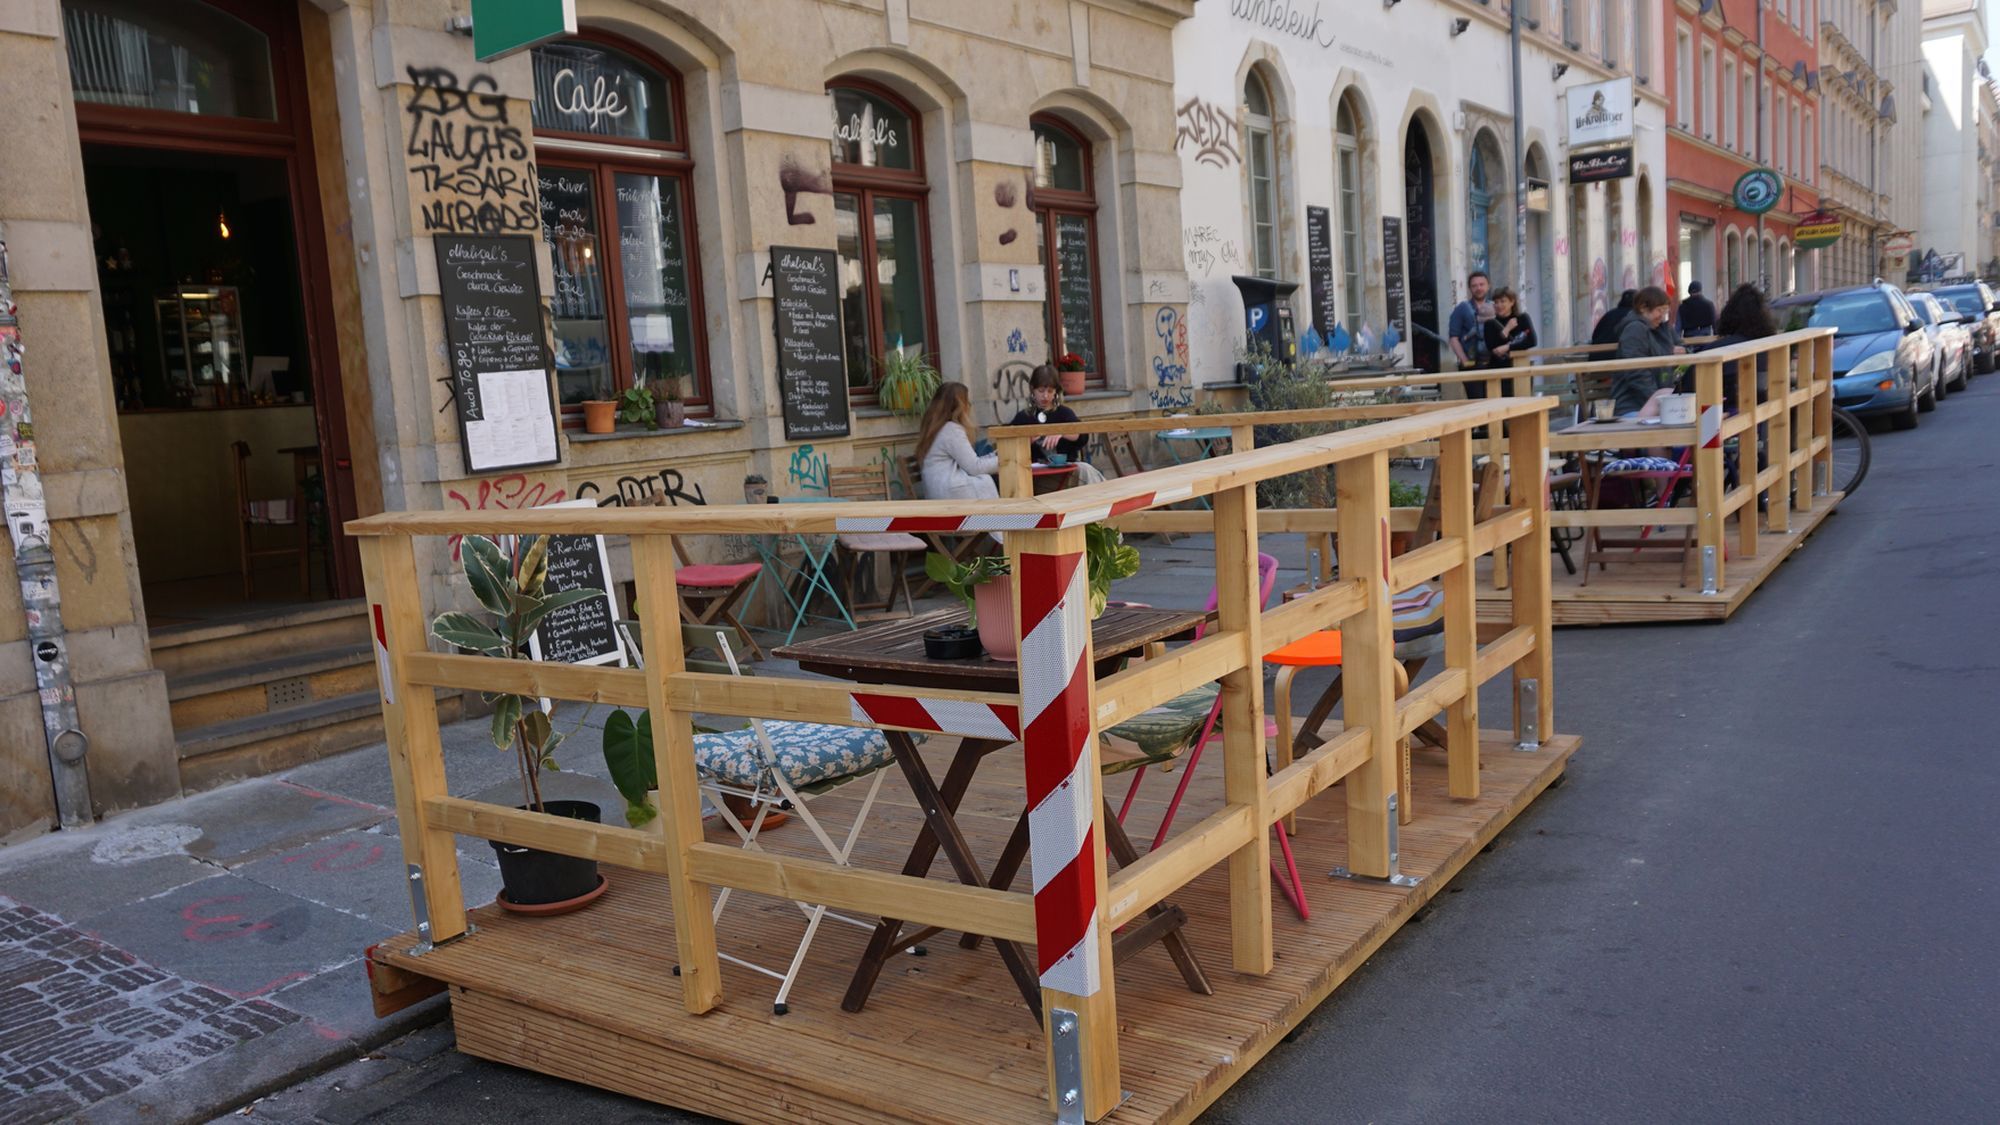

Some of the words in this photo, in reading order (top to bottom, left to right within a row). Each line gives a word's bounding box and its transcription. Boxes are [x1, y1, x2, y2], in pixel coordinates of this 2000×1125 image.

[553, 68, 628, 129] Café
[1250, 307, 1264, 328] P
[466, 387, 479, 419] Auch
